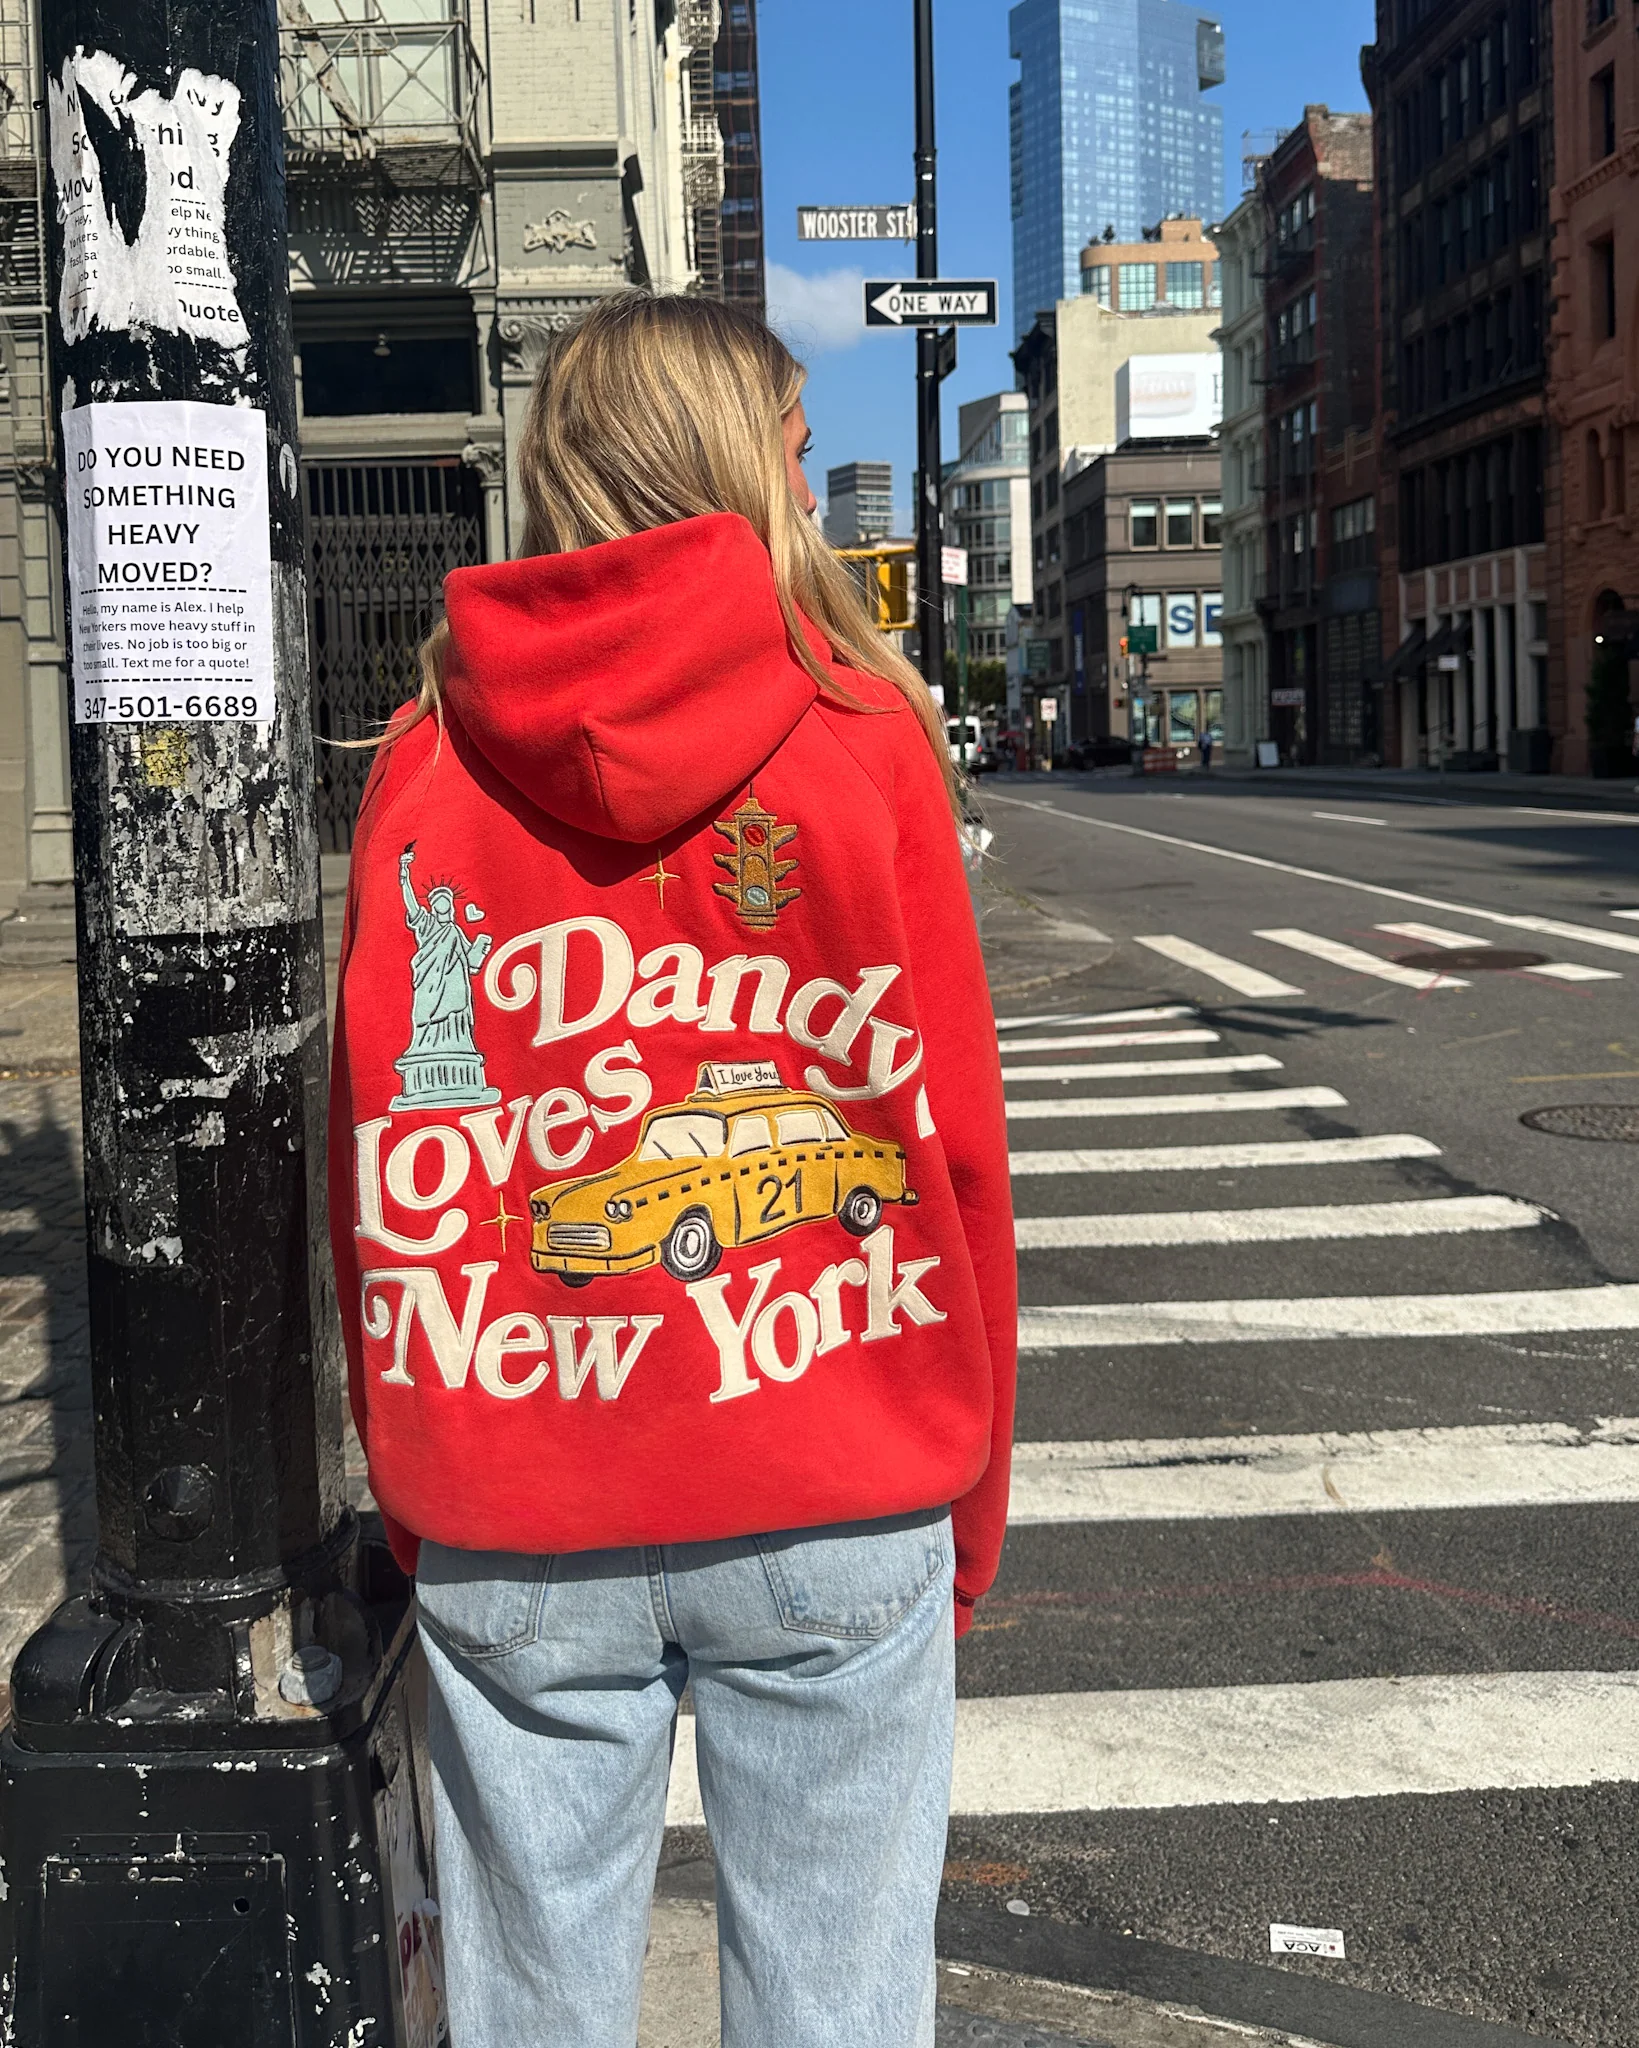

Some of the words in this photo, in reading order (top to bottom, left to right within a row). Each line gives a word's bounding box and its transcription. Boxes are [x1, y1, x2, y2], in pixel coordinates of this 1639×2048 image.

[171, 201, 192, 221] elp
[185, 226, 220, 244] thing
[802, 211, 878, 239] WOOSTER
[886, 211, 907, 239] ST
[186, 265, 226, 280] small.
[178, 298, 239, 323] uote
[889, 295, 928, 312] ONE
[938, 294, 978, 312] WAY
[78, 448, 97, 473] DO
[104, 446, 162, 468] YOU
[172, 446, 245, 472] NEED
[83, 485, 236, 510] SOMETHING
[107, 523, 200, 545] HEAVY
[98, 561, 213, 584] MOVED?
[82, 603, 99, 616] Hello,
[100, 604, 119, 616] my
[122, 603, 158, 613] name
[160, 601, 171, 612] is
[174, 601, 207, 612] Alex.
[217, 602, 245, 617] help
[79, 623, 91, 635] New
[91, 621, 127, 633] Yorkers
[130, 622, 166, 631] move
[169, 619, 208, 634] heavy
[211, 621, 242, 632] stuff
[243, 621, 256, 633] in
[83, 640, 96, 653] their
[96, 638, 124, 650] lives.
[127, 639, 146, 650] No
[148, 638, 169, 652] job
[172, 638, 183, 649] is
[186, 639, 209, 649] too
[212, 638, 231, 652] big
[234, 641, 248, 651] or
[83, 660, 93, 671] too
[93, 657, 119, 669] small.
[121, 657, 149, 668] Text
[152, 658, 172, 668] me
[175, 656, 195, 667] for
[197, 659, 206, 668] a
[208, 658, 250, 671] quote!
[83, 694, 258, 720] 347-501-6689
[484, 915, 924, 1101] Dandy
[717, 1069, 729, 1085] I
[731, 1067, 754, 1086] Love
[754, 1066, 779, 1083] You
[352, 1038, 653, 1256] Loves
[757, 1166, 804, 1225] 21
[360, 1261, 664, 1402] New
[686, 1224, 949, 1405] York
[1284, 1942, 1319, 1952] ACA
